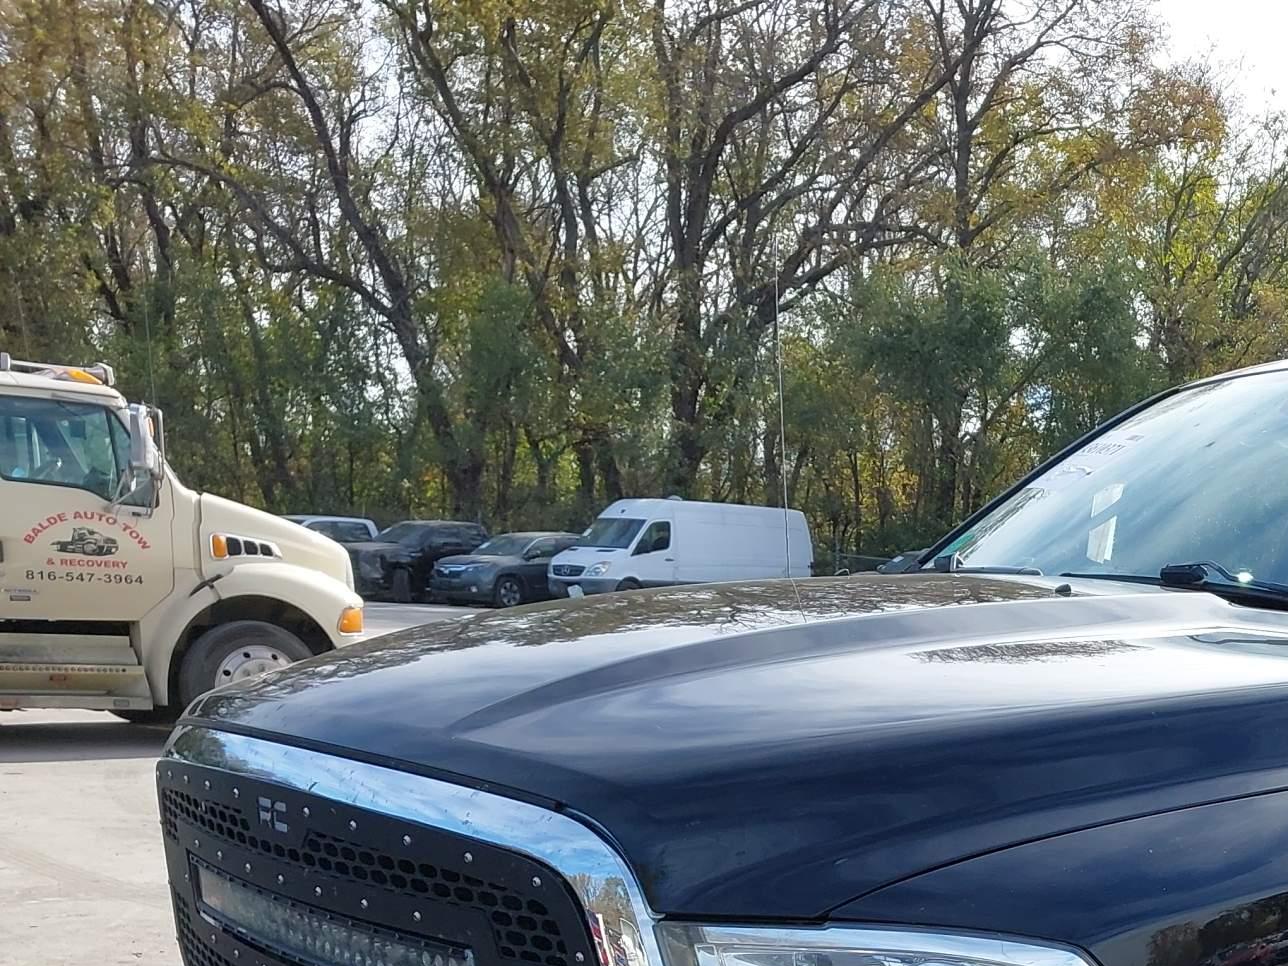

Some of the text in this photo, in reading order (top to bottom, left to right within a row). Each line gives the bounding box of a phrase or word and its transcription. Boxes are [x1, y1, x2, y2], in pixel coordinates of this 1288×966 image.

[23, 510, 152, 551] BALDE AUTO TOW
[46, 557, 129, 569] & RECOVERY
[25, 570, 144, 585] 816-547-3964
